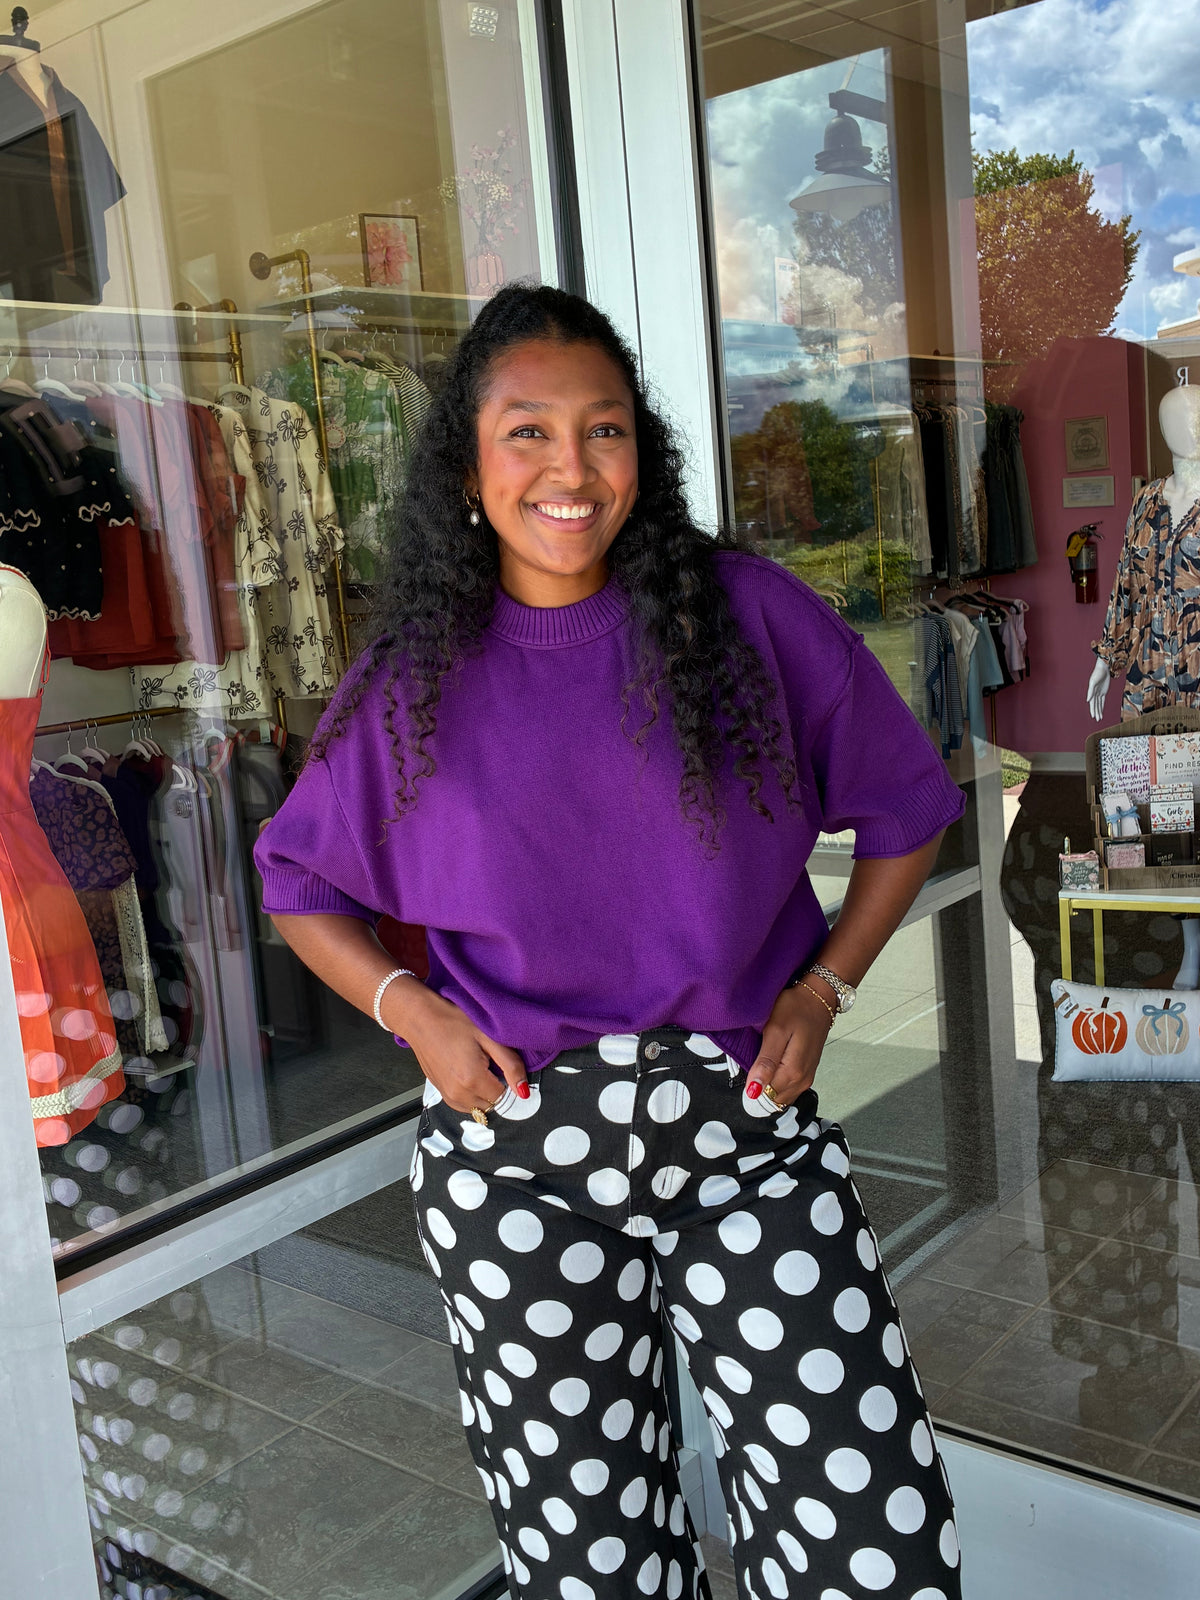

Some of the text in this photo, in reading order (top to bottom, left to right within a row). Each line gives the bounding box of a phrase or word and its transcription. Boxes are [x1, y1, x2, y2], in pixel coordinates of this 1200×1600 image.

[1116, 761, 1147, 774] all this
[1164, 762, 1184, 770] FIND
[1167, 807, 1184, 816] Girls
